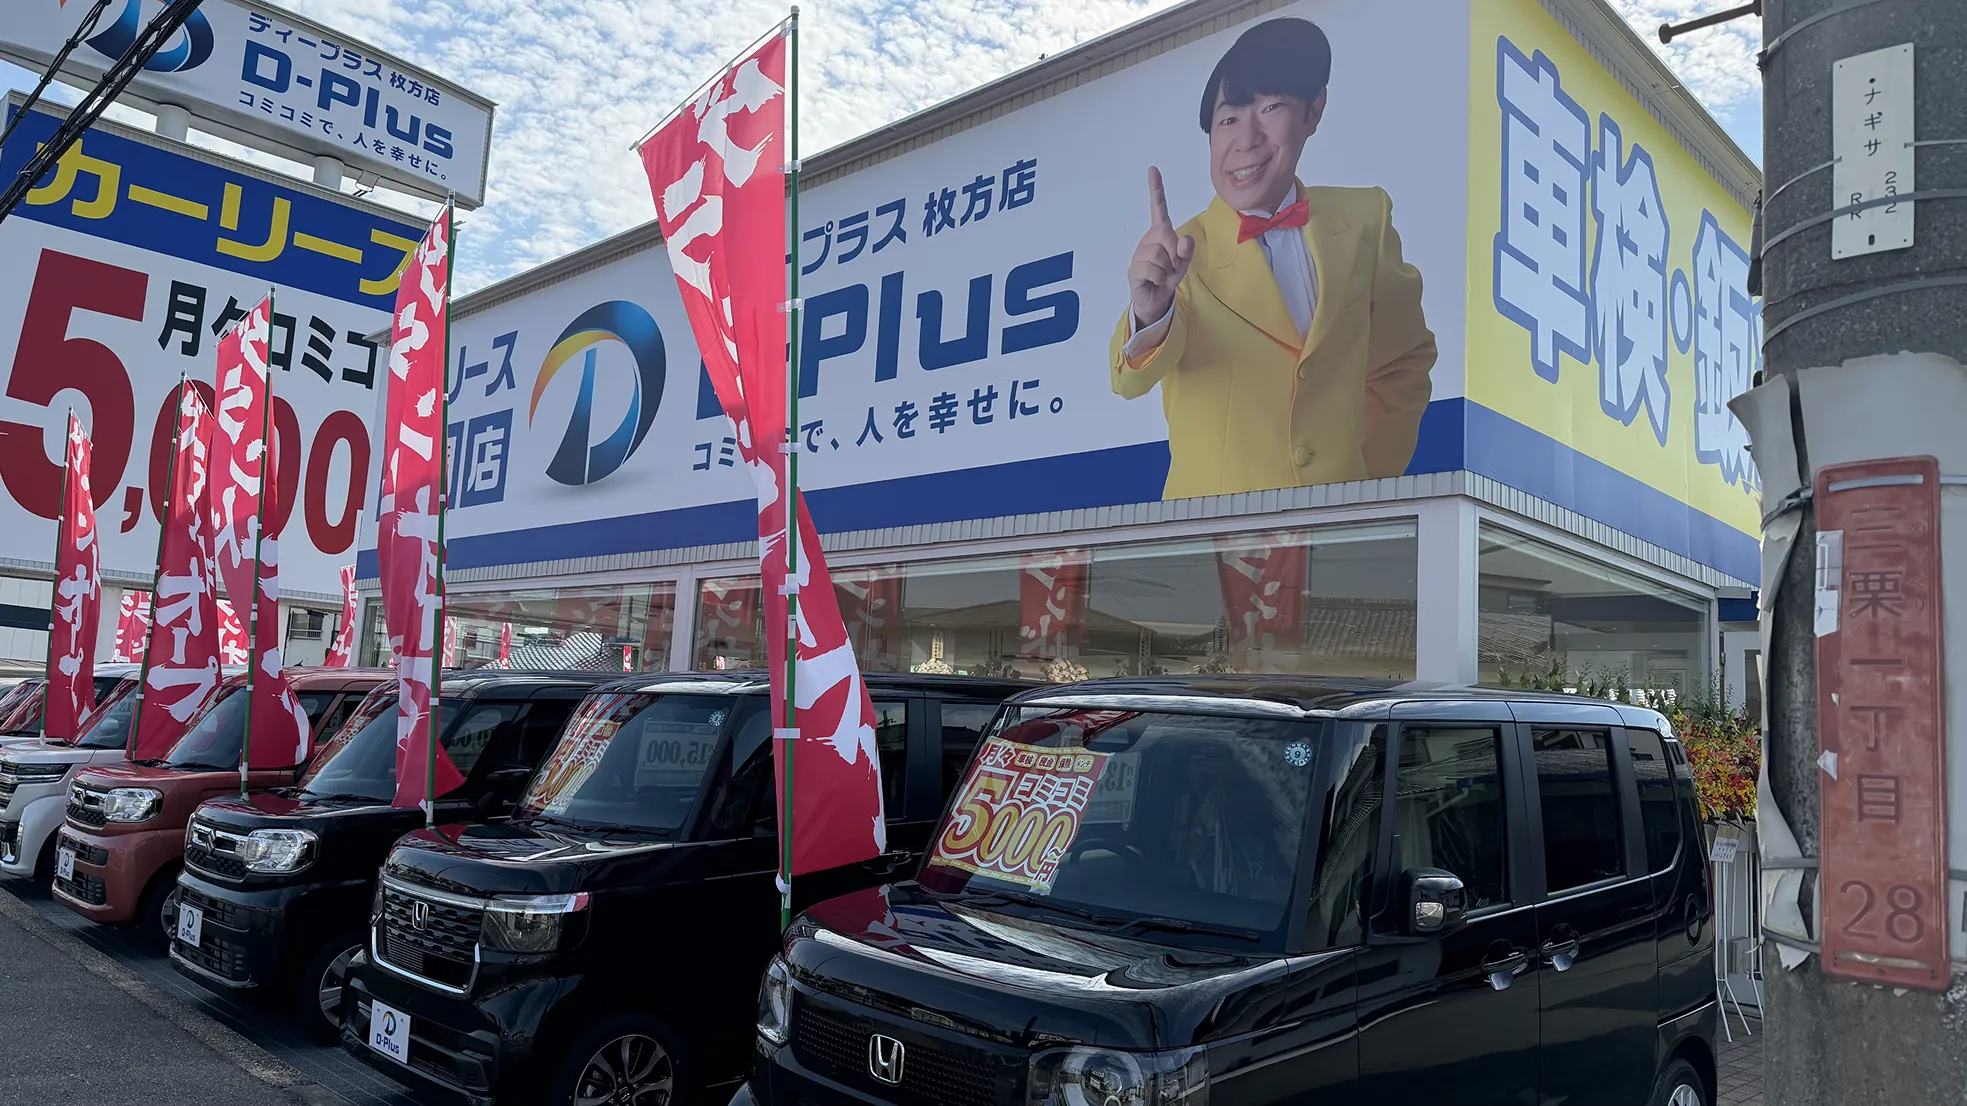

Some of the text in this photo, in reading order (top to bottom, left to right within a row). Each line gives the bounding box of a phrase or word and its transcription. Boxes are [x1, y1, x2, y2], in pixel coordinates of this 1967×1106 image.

[241, 38, 454, 160] D-Plus
[249, 11, 440, 107] ディープラス 枚方店
[239, 90, 447, 180] コミコミで、人を幸せに。
[1864, 87, 1883, 157] ナギサ
[922, 158, 1037, 238] 枚方店
[692, 379, 1064, 471] コミで、人を幸せに。
[1848, 508, 1905, 824] 三栗一丁目
[939, 765, 1077, 877] 5000
[1013, 773, 1094, 812] コミコミ
[181, 927, 196, 942] D-Plus
[1839, 878, 1925, 945] 28
[375, 1032, 400, 1055] D-Plus
